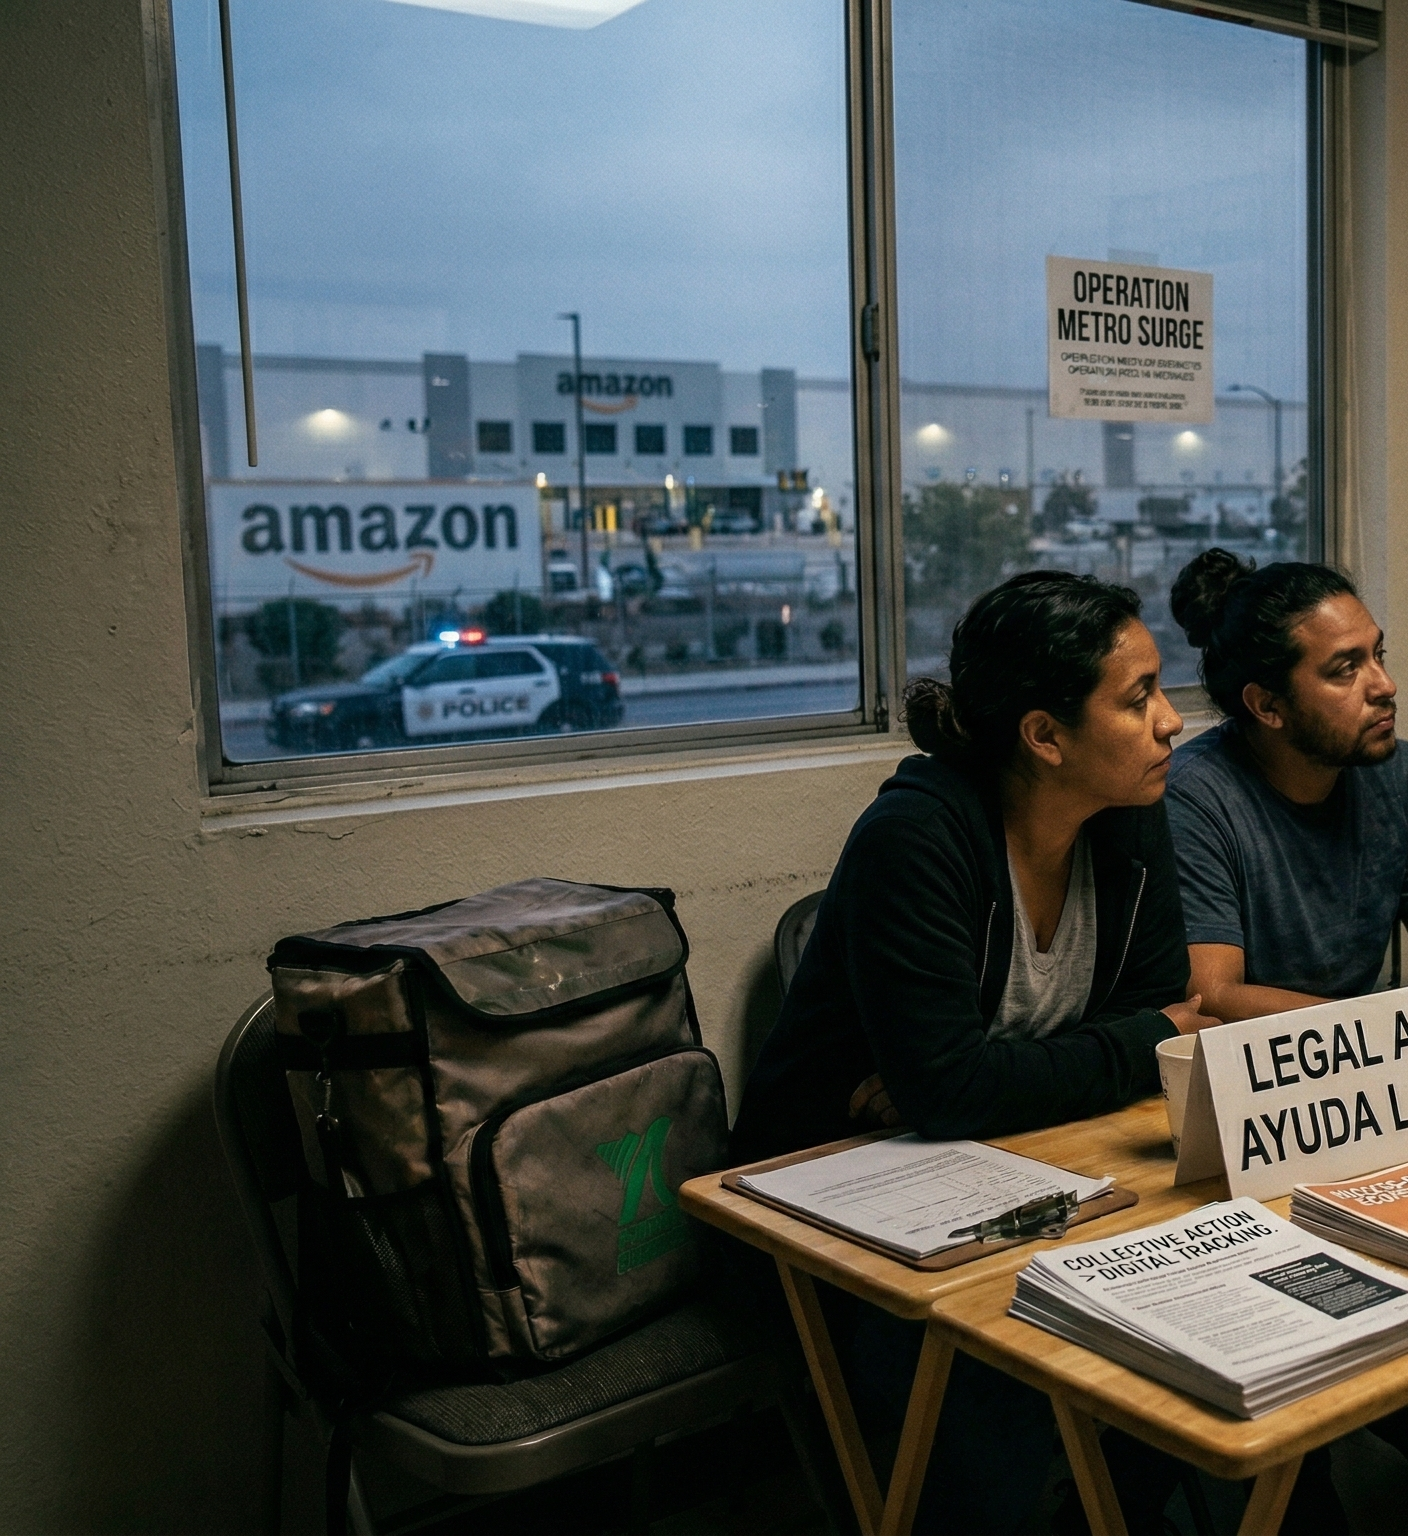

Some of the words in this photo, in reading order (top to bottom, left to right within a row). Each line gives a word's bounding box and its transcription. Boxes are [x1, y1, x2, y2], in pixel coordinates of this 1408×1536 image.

[1073, 270, 1189, 312] OPERATION
[1058, 308, 1132, 345] METRO
[1138, 315, 1204, 350] SURGE
[557, 372, 673, 398] amazon
[241, 502, 518, 554] amazon
[443, 694, 530, 719] POLICE
[1243, 1019, 1384, 1093] LEGAL
[1241, 1090, 1383, 1172] AYUDA
[1062, 1233, 1186, 1271] COLLECTIVE
[1184, 1210, 1257, 1241] ACTION
[1097, 1253, 1181, 1280] DIGITAL
[1173, 1223, 1279, 1261] TRACKING.
